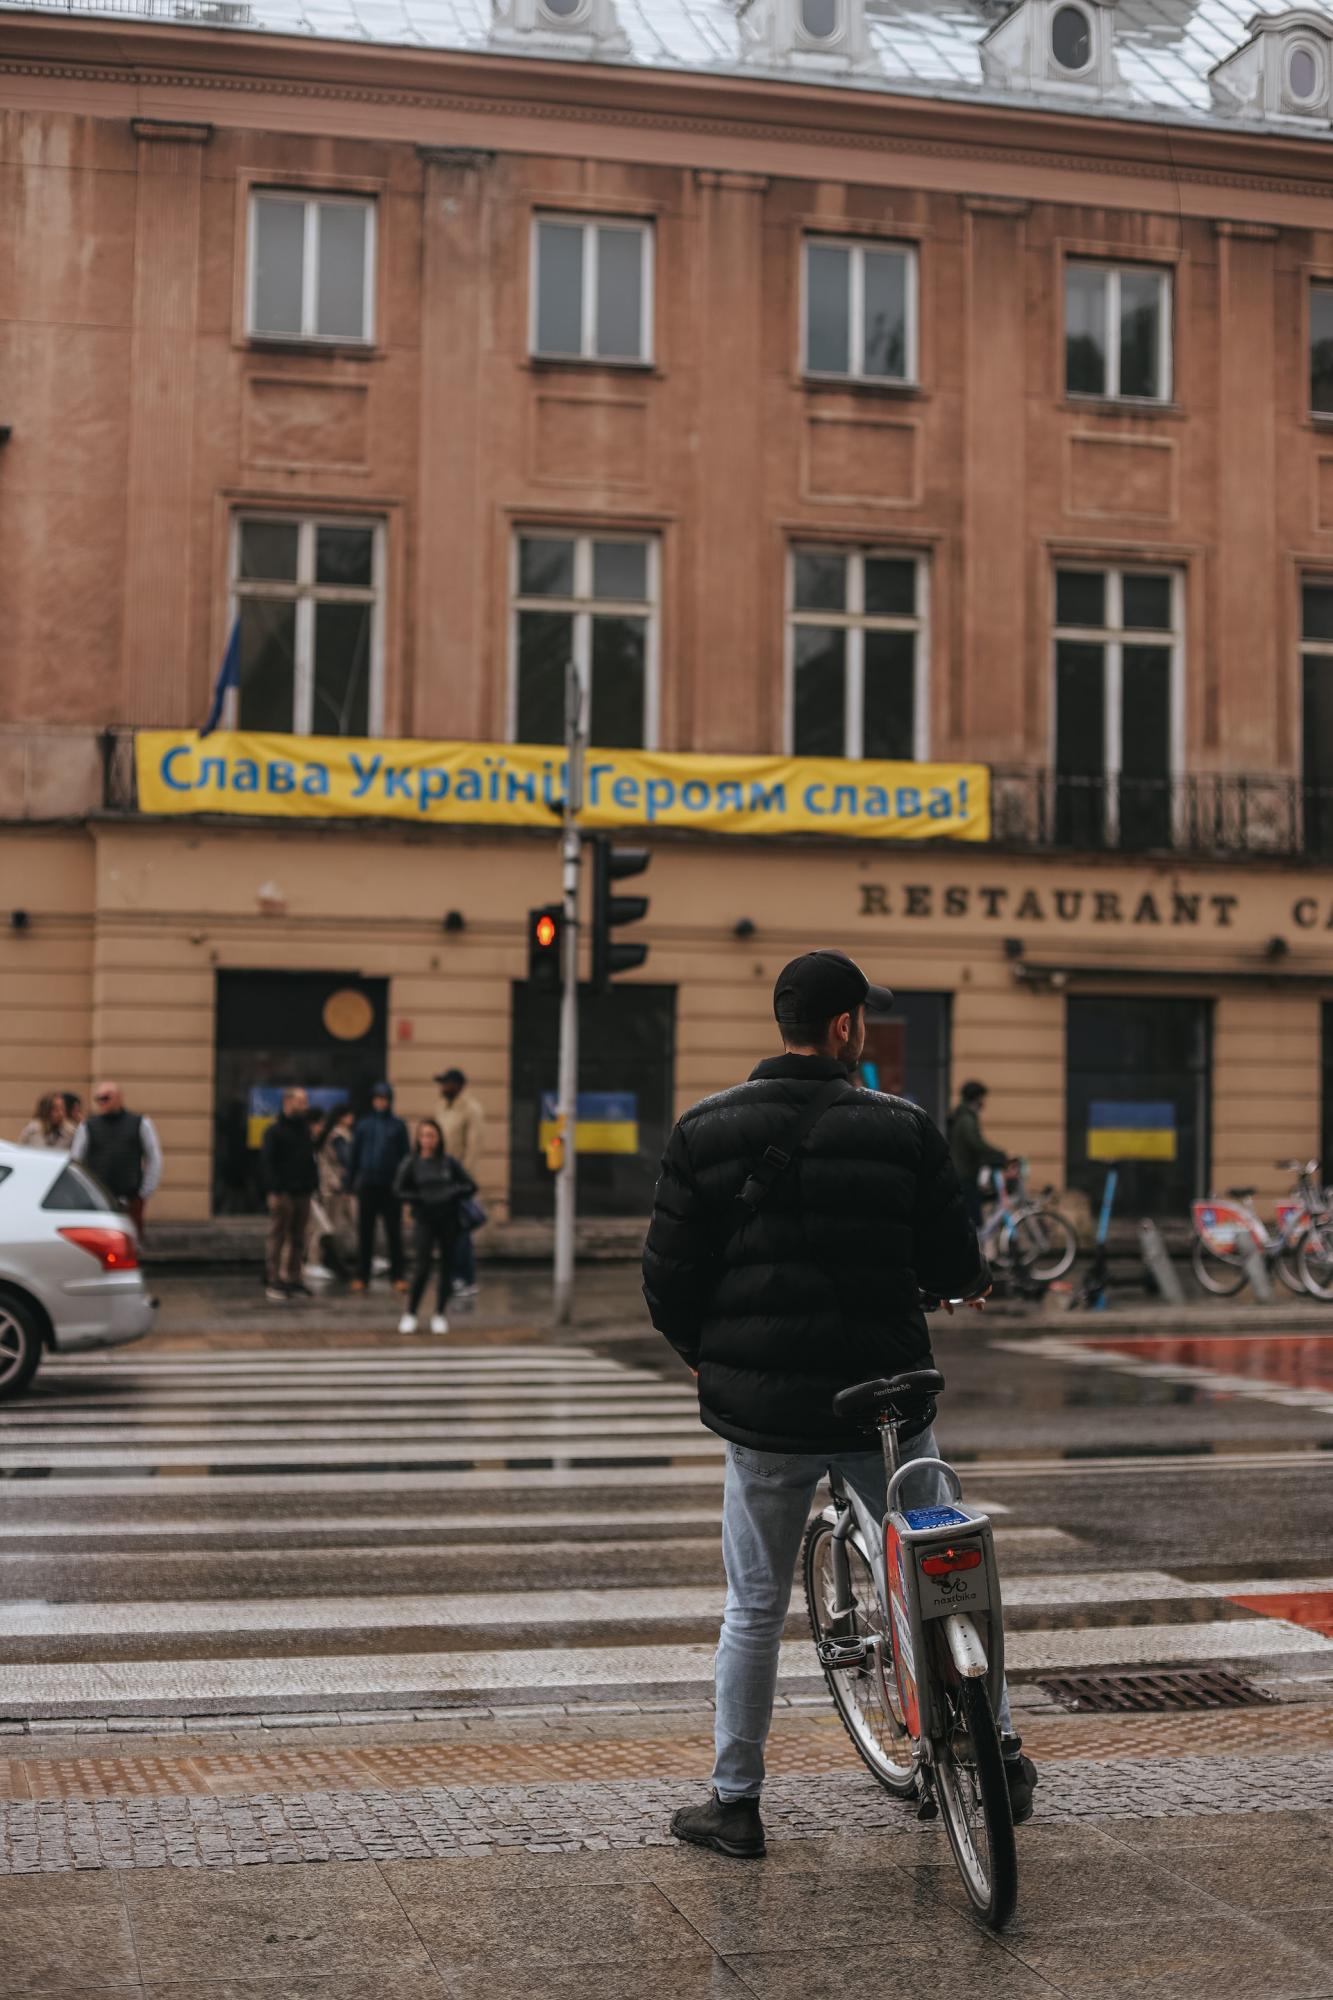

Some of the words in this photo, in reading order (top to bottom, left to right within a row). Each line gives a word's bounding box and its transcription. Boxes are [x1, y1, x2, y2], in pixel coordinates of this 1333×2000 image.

[160, 746, 329, 796] Слава
[588, 764, 786, 821] Героям
[803, 779, 969, 819] слава!
[859, 884, 1237, 928] RESTAURANT
[1291, 897, 1333, 930] C
[934, 1592, 977, 1606] nextbike
